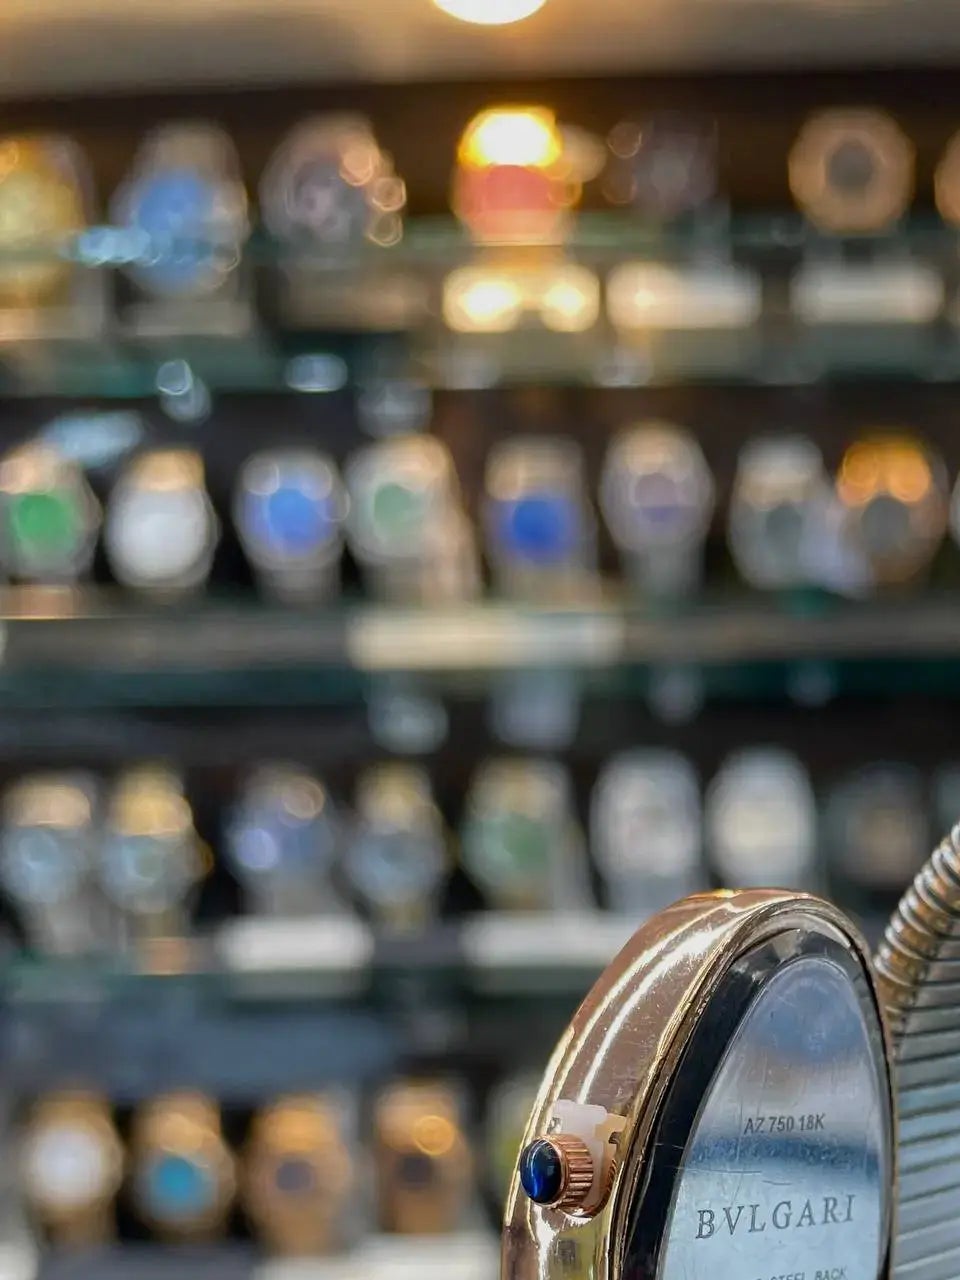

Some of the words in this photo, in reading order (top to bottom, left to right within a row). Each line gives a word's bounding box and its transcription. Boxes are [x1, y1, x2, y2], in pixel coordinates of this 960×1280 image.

[744, 1117, 765, 1135] AZ
[768, 1115, 795, 1133] 750
[799, 1112, 826, 1131] 18K
[695, 1194, 856, 1239] BVLGARI
